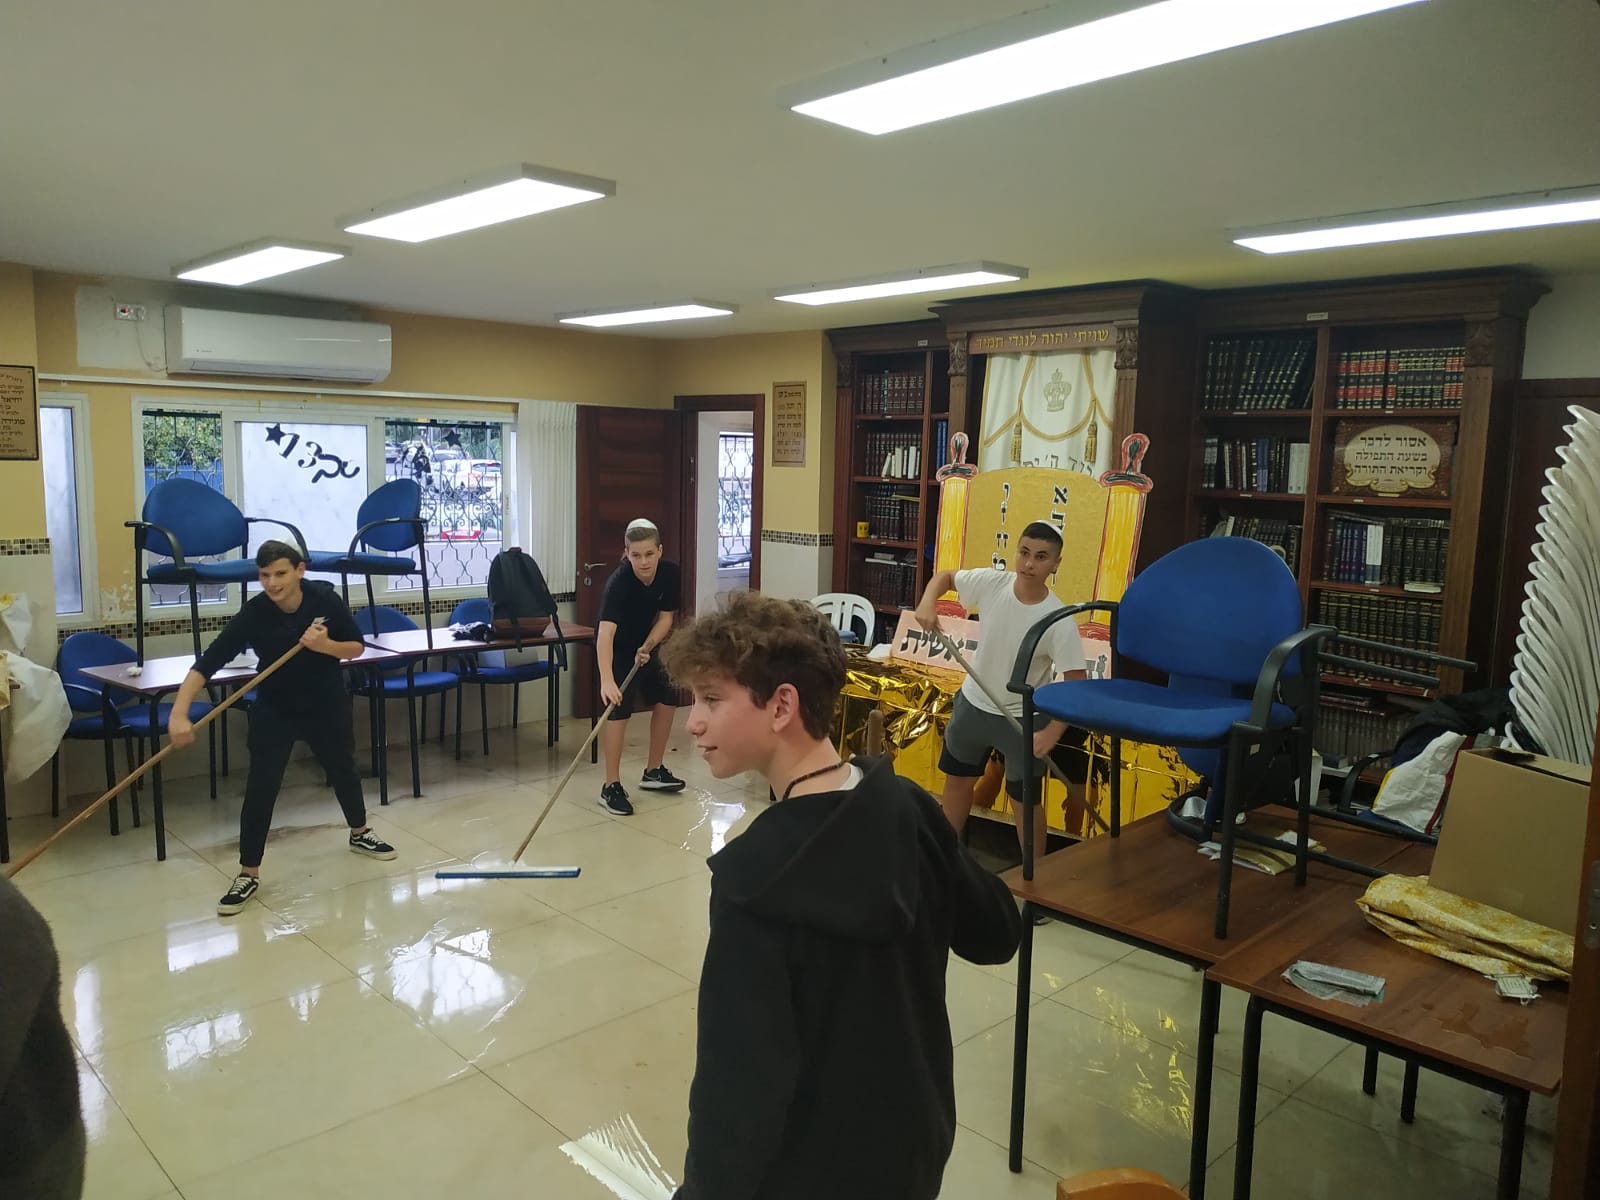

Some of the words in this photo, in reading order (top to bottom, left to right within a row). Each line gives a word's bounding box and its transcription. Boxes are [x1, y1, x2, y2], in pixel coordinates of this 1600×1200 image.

[976, 335, 1004, 349] תמיד
[1008, 331, 1037, 348] לנגדי
[1041, 332, 1068, 345] יהוה
[1073, 329, 1109, 343] שויתי
[1360, 432, 1391, 447] לדבר
[1395, 436, 1427, 447] אסור
[1355, 448, 1394, 461] התפילה
[1397, 452, 1427, 462] בשעת
[1354, 464, 1387, 474] התורה
[1390, 465, 1427, 477] וקריאת
[1053, 485, 1068, 504] א
